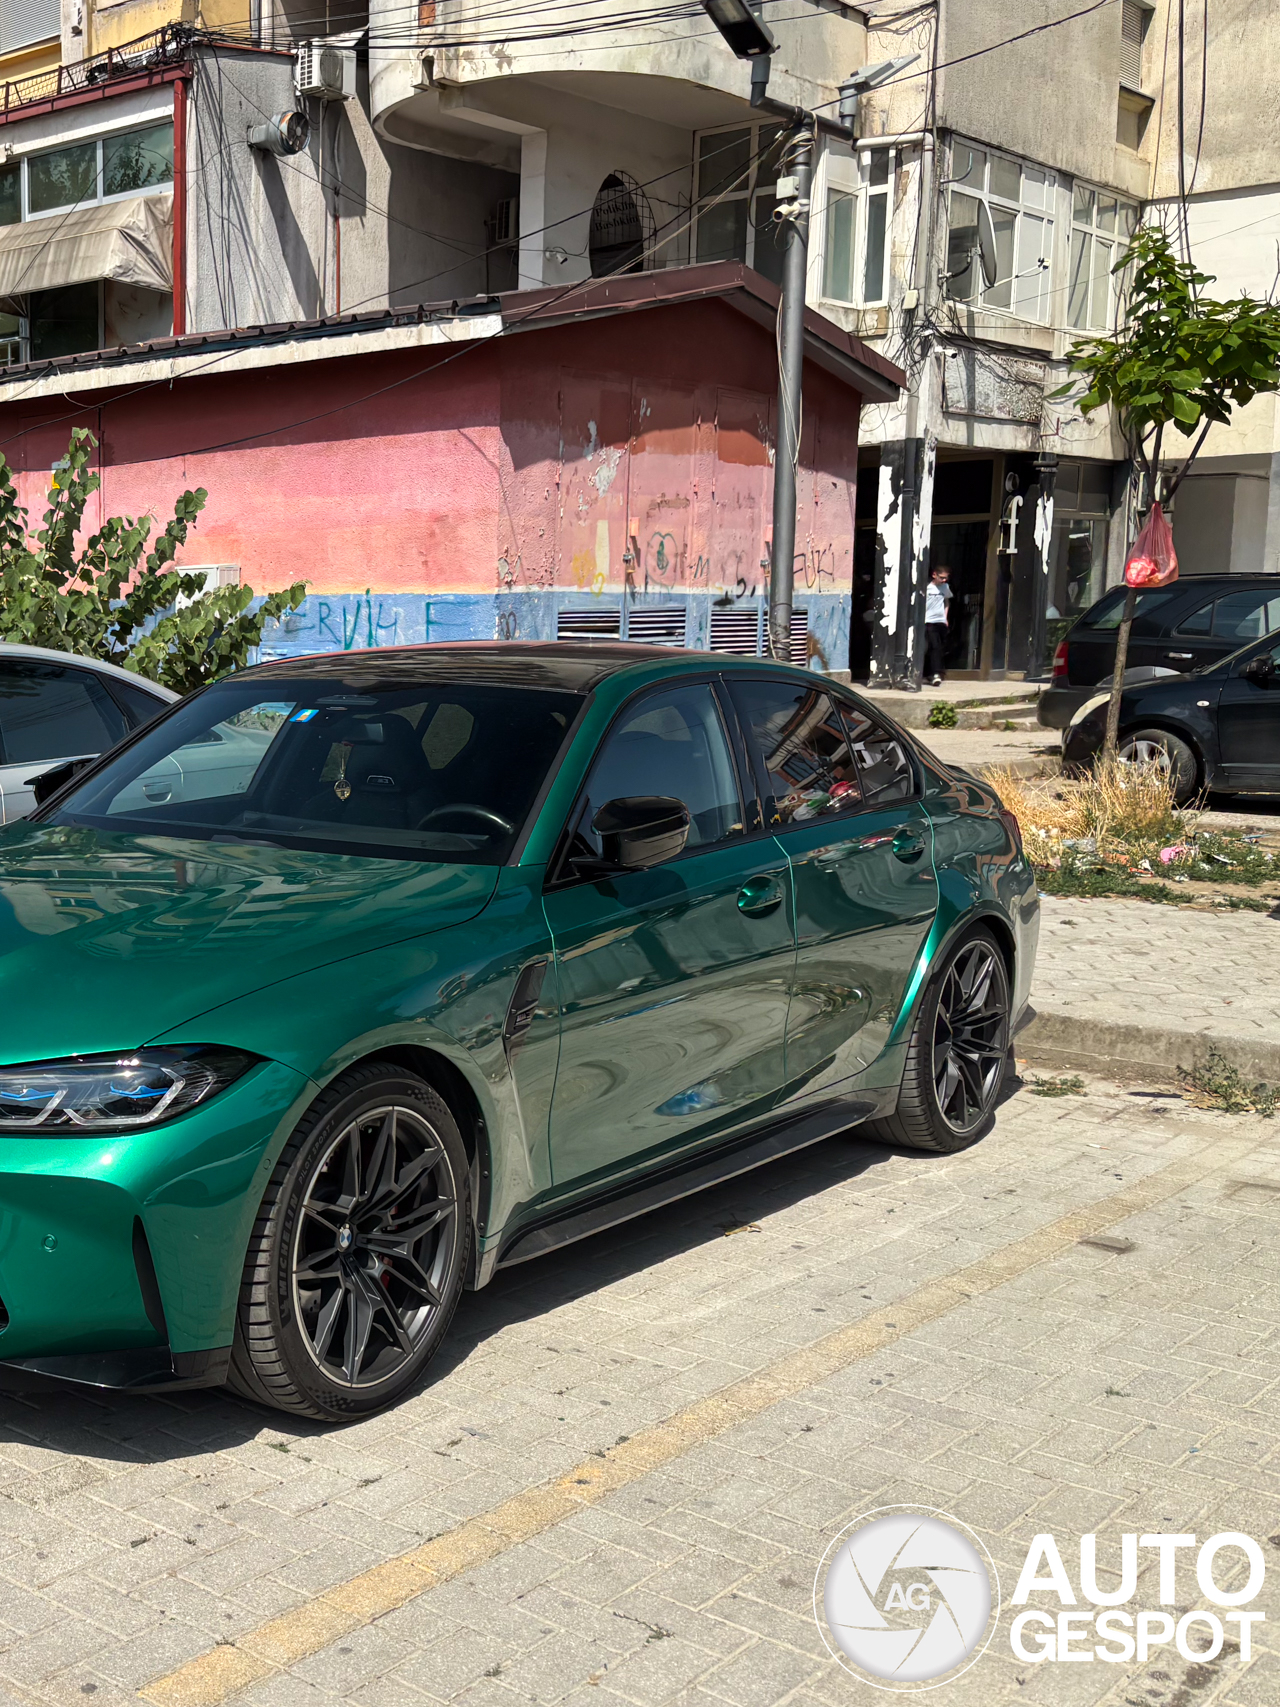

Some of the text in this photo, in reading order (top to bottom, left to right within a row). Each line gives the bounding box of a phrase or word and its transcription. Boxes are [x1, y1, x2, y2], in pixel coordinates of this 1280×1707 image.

[298, 1124, 331, 1185] PILOT SPORT
[279, 1193, 299, 1297] MICHELIN
